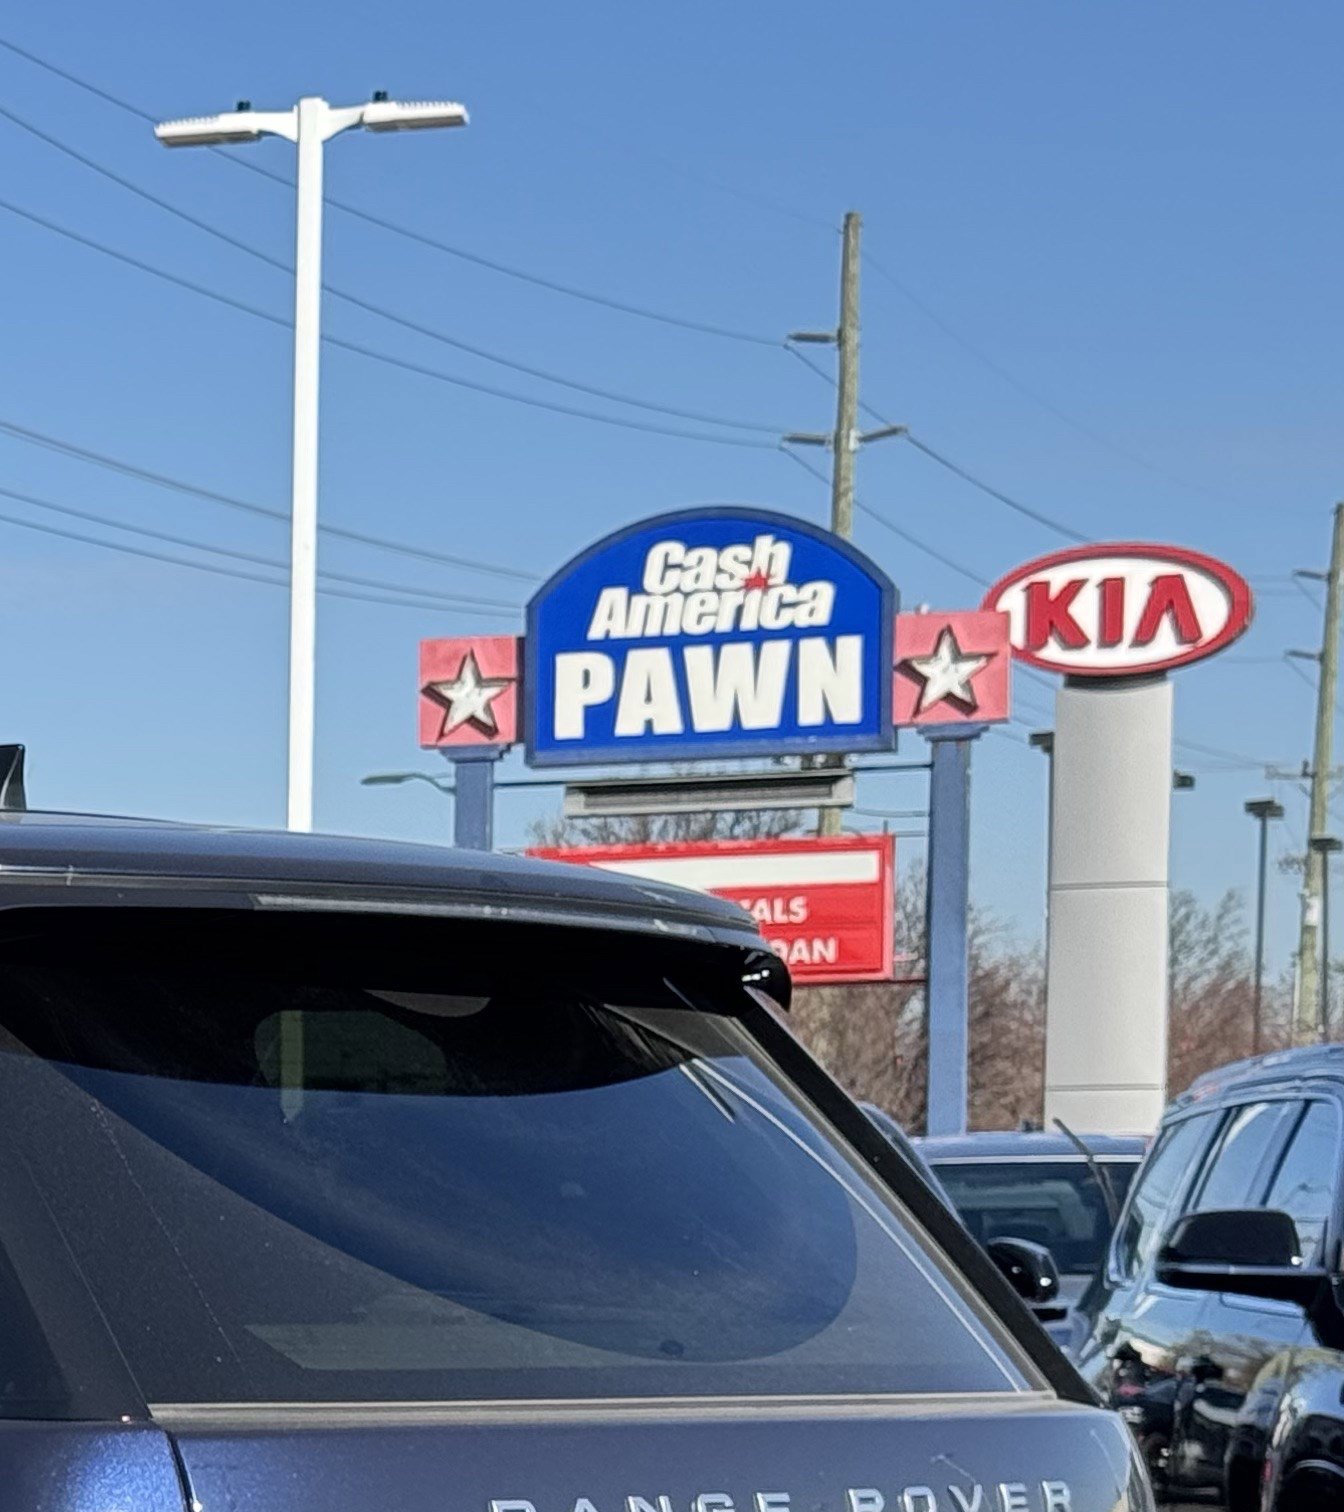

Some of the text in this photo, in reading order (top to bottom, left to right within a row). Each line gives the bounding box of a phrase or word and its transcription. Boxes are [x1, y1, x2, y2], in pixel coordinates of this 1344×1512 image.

[642, 534, 793, 595] Cash
[586, 580, 836, 641] America
[1023, 573, 1203, 649] KIA
[554, 634, 863, 741] PAWN
[739, 895, 808, 925] ALS
